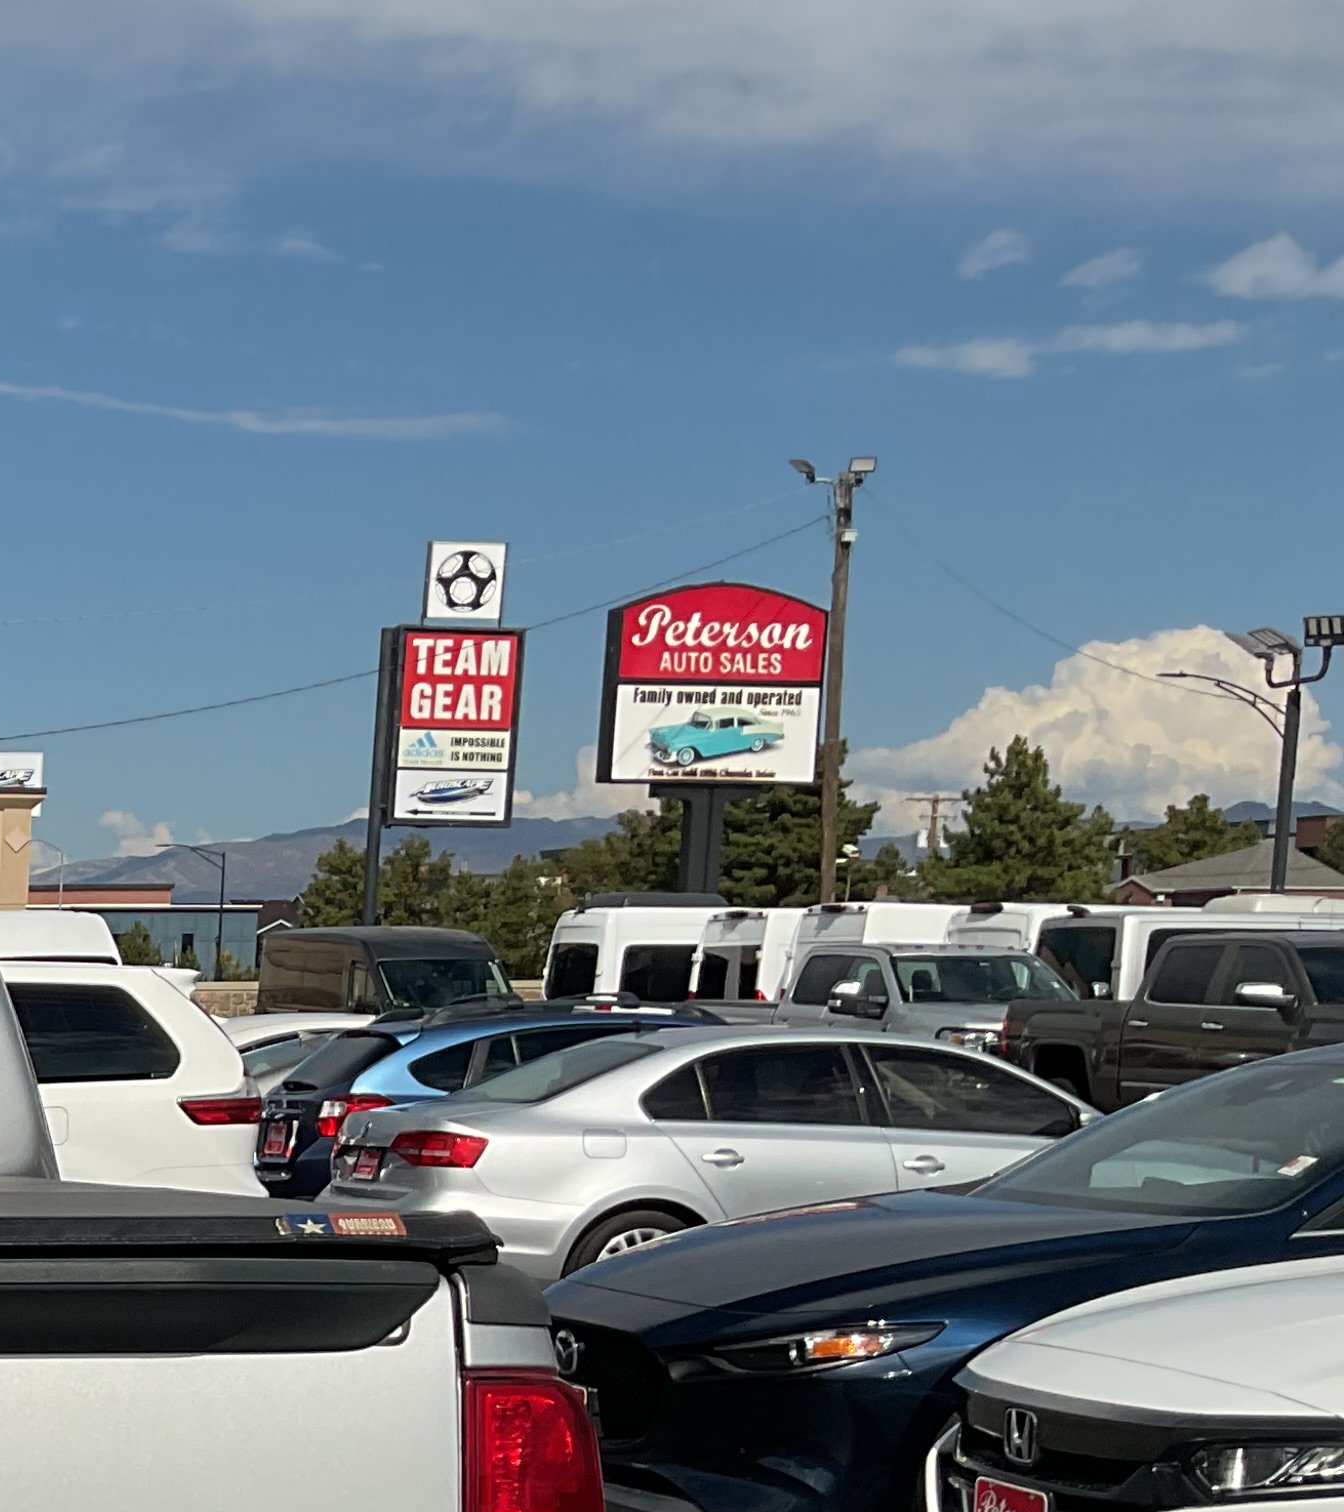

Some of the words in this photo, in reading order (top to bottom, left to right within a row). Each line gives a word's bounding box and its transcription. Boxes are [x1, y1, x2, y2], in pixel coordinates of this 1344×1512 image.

[631, 604, 812, 650] Peterson
[412, 638, 511, 677] TEAM
[659, 651, 712, 673] AUTO
[719, 653, 782, 675] SALES
[410, 682, 503, 721] GEAR
[633, 687, 672, 706] Family
[676, 688, 716, 705] owned
[720, 689, 743, 705] and
[746, 690, 802, 707] operated
[450, 737, 505, 748] IMPOSSIBLE
[450, 752, 460, 761] IS
[462, 752, 502, 763] NOTHING
